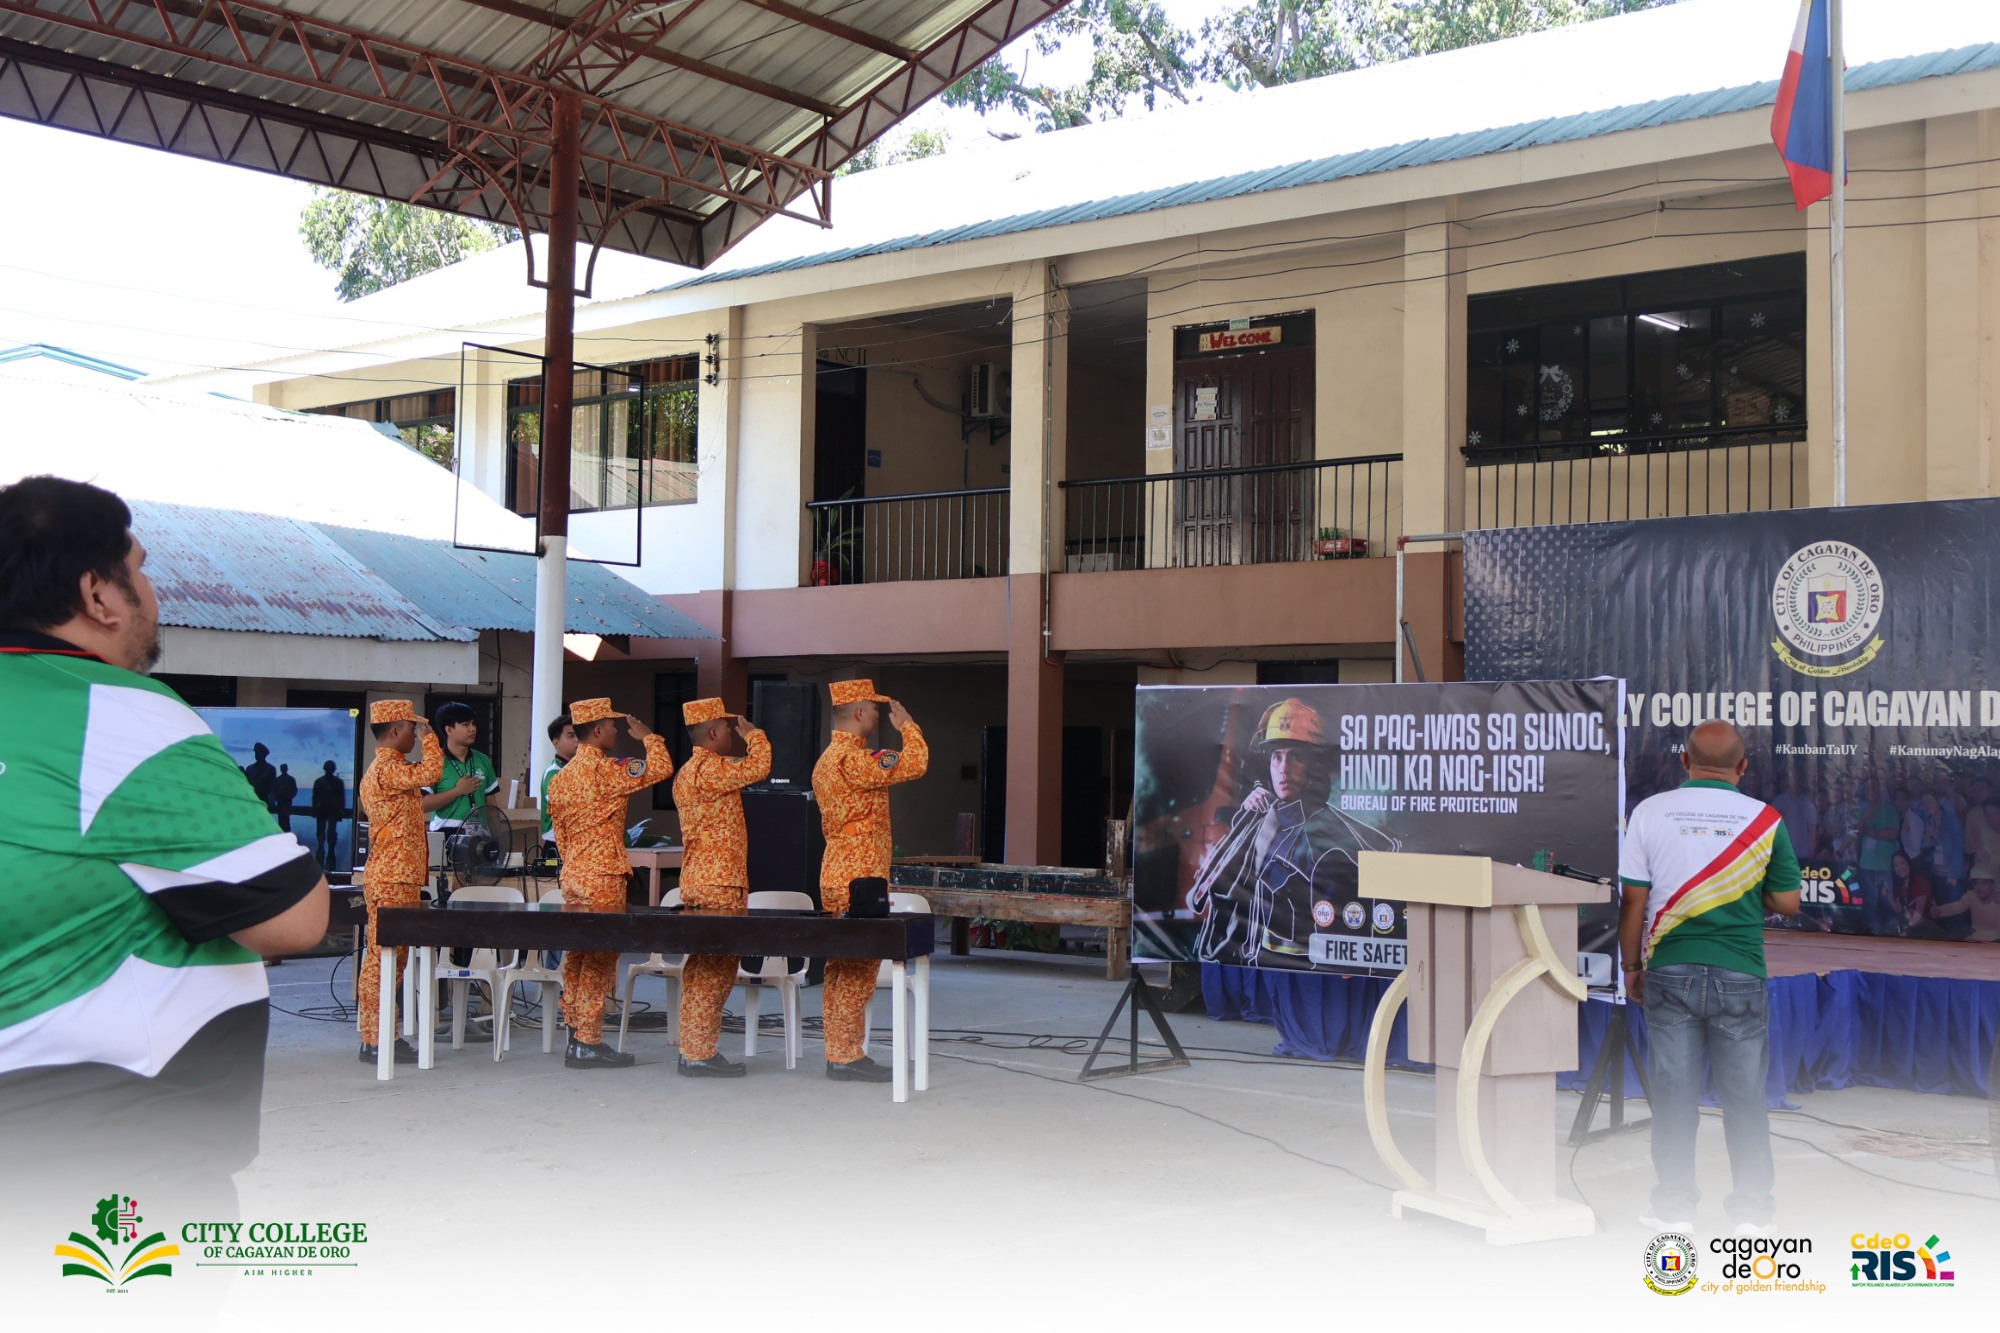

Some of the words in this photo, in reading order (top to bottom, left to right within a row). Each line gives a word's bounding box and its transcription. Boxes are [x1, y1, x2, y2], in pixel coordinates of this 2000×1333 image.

[1209, 331, 1272, 349] WELCOME
[835, 346, 854, 363] NC
[1776, 584, 1787, 616] CITY
[1782, 562, 1795, 580] OF
[1797, 544, 1859, 562] CAGAYAN
[1859, 560, 1875, 579] DE
[1869, 583, 1880, 614] ORO
[1792, 632, 1862, 653] PHILIPPINES
[1779, 691, 1816, 727] OF
[1824, 690, 1971, 727] CAGAYAN
[1340, 714, 1368, 751] SA
[1374, 713, 1480, 751] PAG-IWAS
[1487, 713, 1517, 751] SA
[1524, 712, 1610, 755] SUNOG,
[1775, 743, 1858, 755] #KaubanTaUY
[1340, 754, 1398, 791] HINDI
[1404, 754, 1432, 791] KA
[1439, 754, 1545, 793] NAG-IISA!
[1341, 795, 1388, 811] BUREAU
[1391, 796, 1407, 812] OF
[1410, 796, 1437, 812] FIRE
[1440, 796, 1518, 814] PROTECTION
[1800, 866, 1832, 880] deO
[1326, 940, 1358, 961] FIRE
